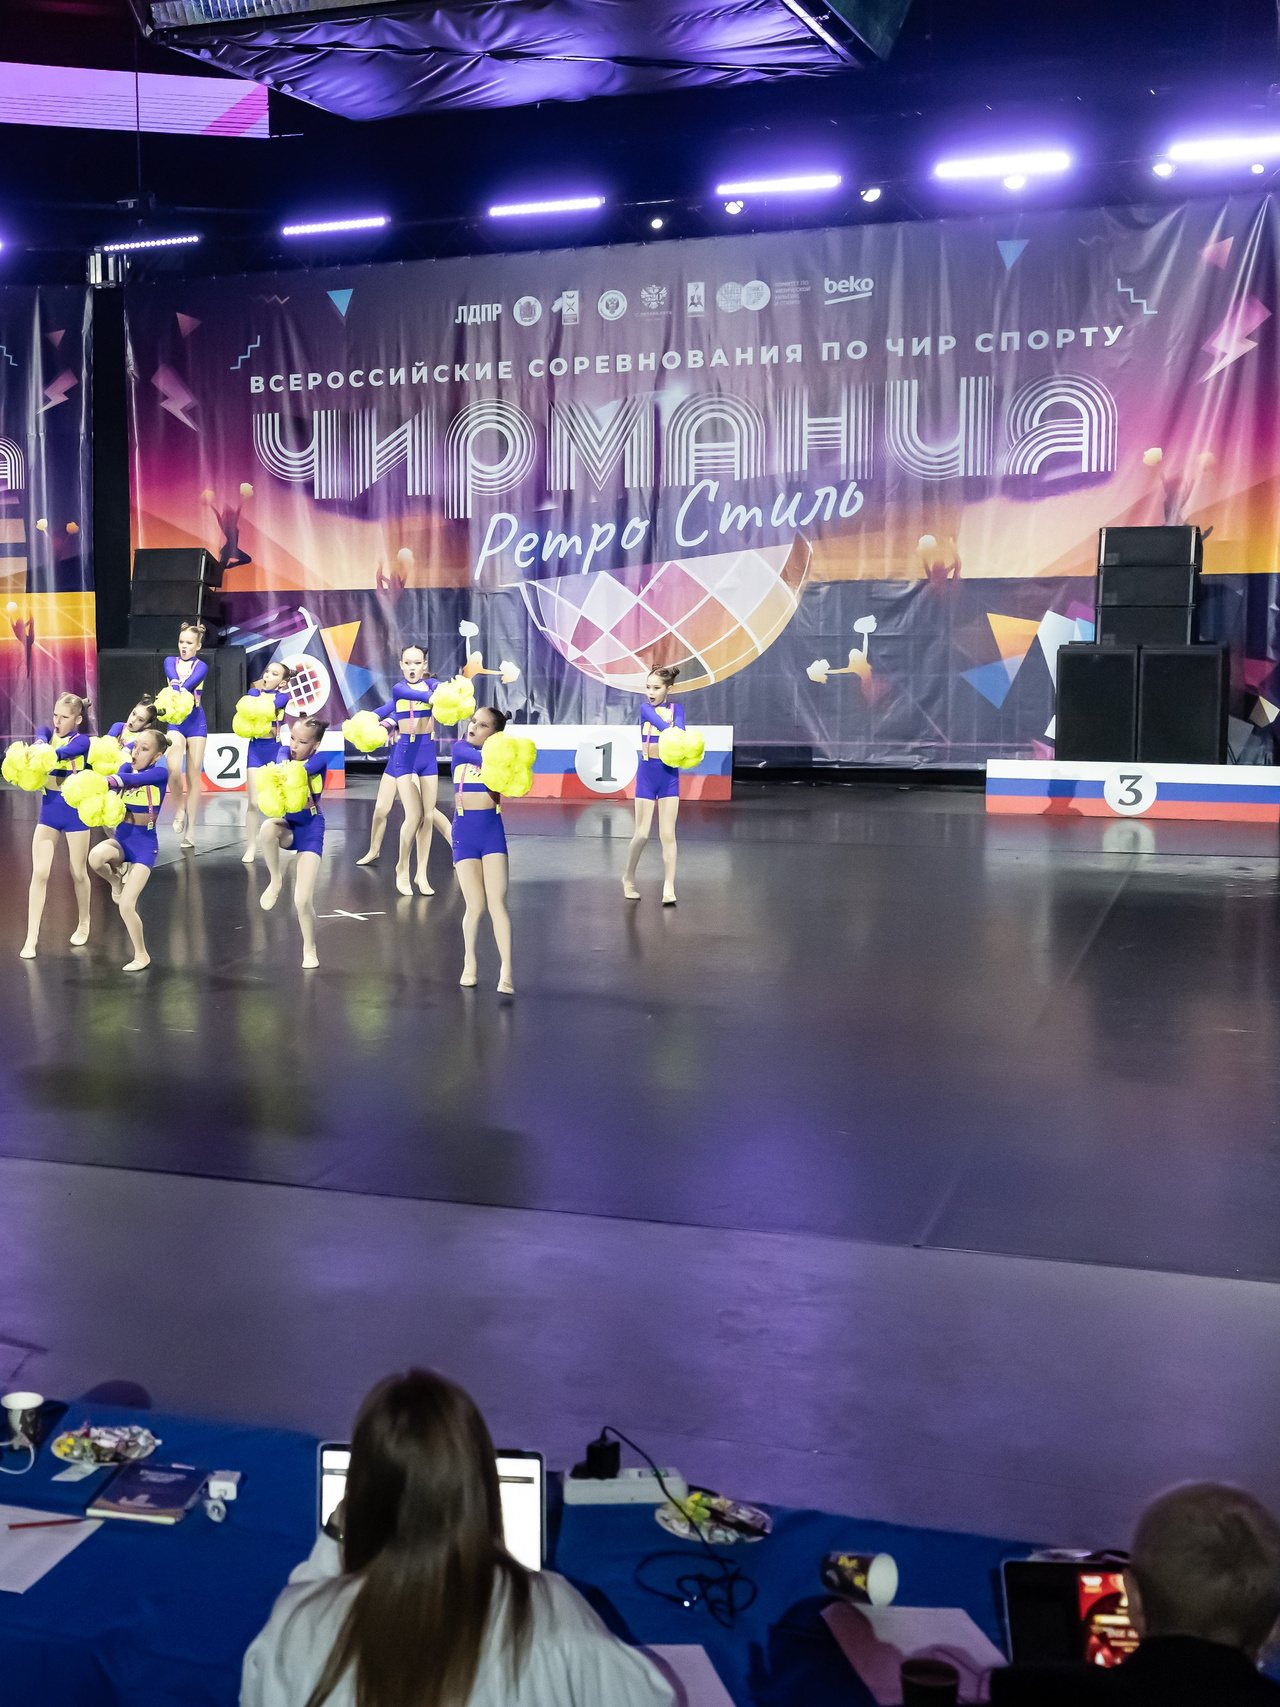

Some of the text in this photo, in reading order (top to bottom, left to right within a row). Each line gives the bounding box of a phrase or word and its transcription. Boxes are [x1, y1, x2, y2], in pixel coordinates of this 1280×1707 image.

[823, 275, 875, 294] beko
[454, 303, 503, 326] ЛДПР
[250, 324, 1125, 394] ВСЕРОССИЙСКИЕ СОРЕВНОВАНИЯ ПО ЧИР СПОРТУ
[474, 478, 865, 581] Ретро Стиль
[216, 745, 241, 780] 2
[595, 741, 618, 783] 1
[1117, 773, 1144, 807] 3
